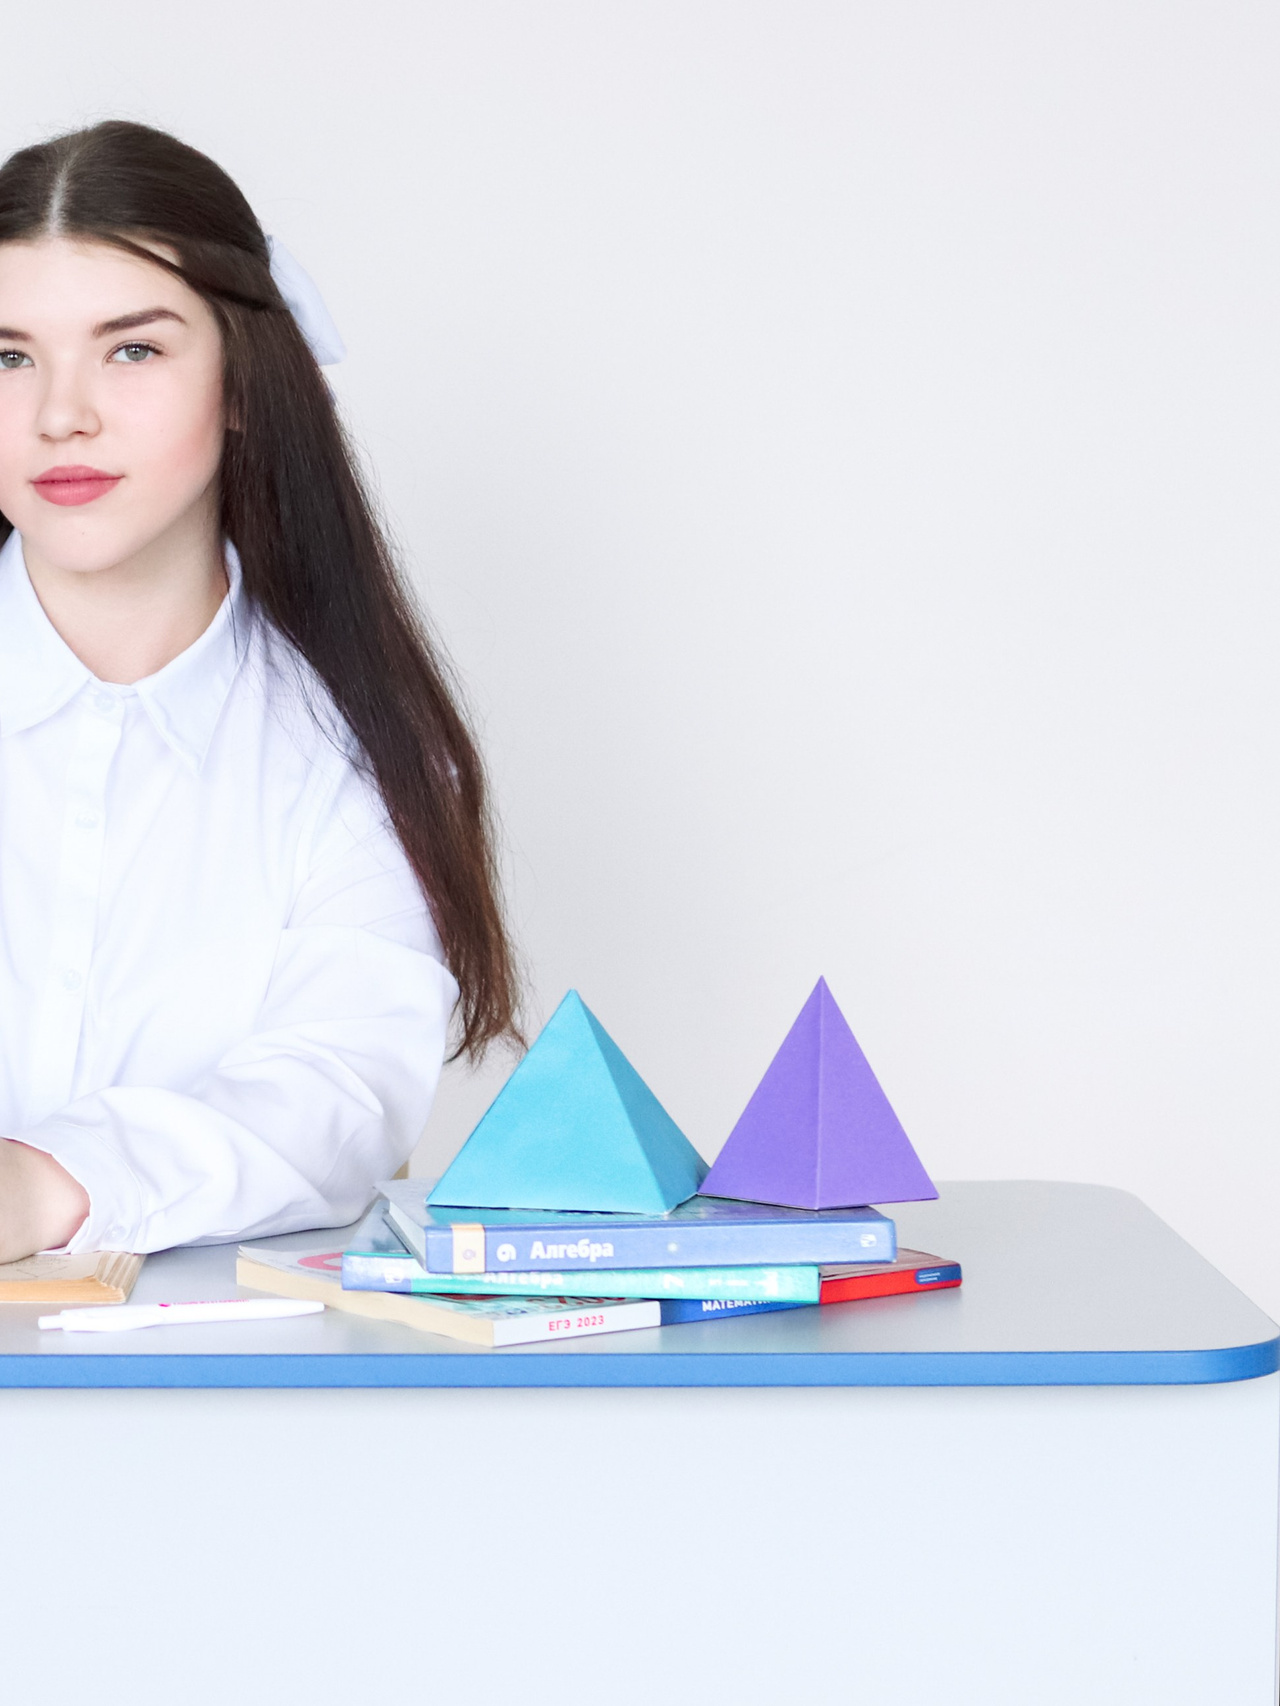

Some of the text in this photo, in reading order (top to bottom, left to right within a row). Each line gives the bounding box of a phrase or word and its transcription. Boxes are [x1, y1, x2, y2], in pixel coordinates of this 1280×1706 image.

[530, 1238, 615, 1262] Алгебра
[548, 1315, 605, 1332] ЕГЭ 2023
